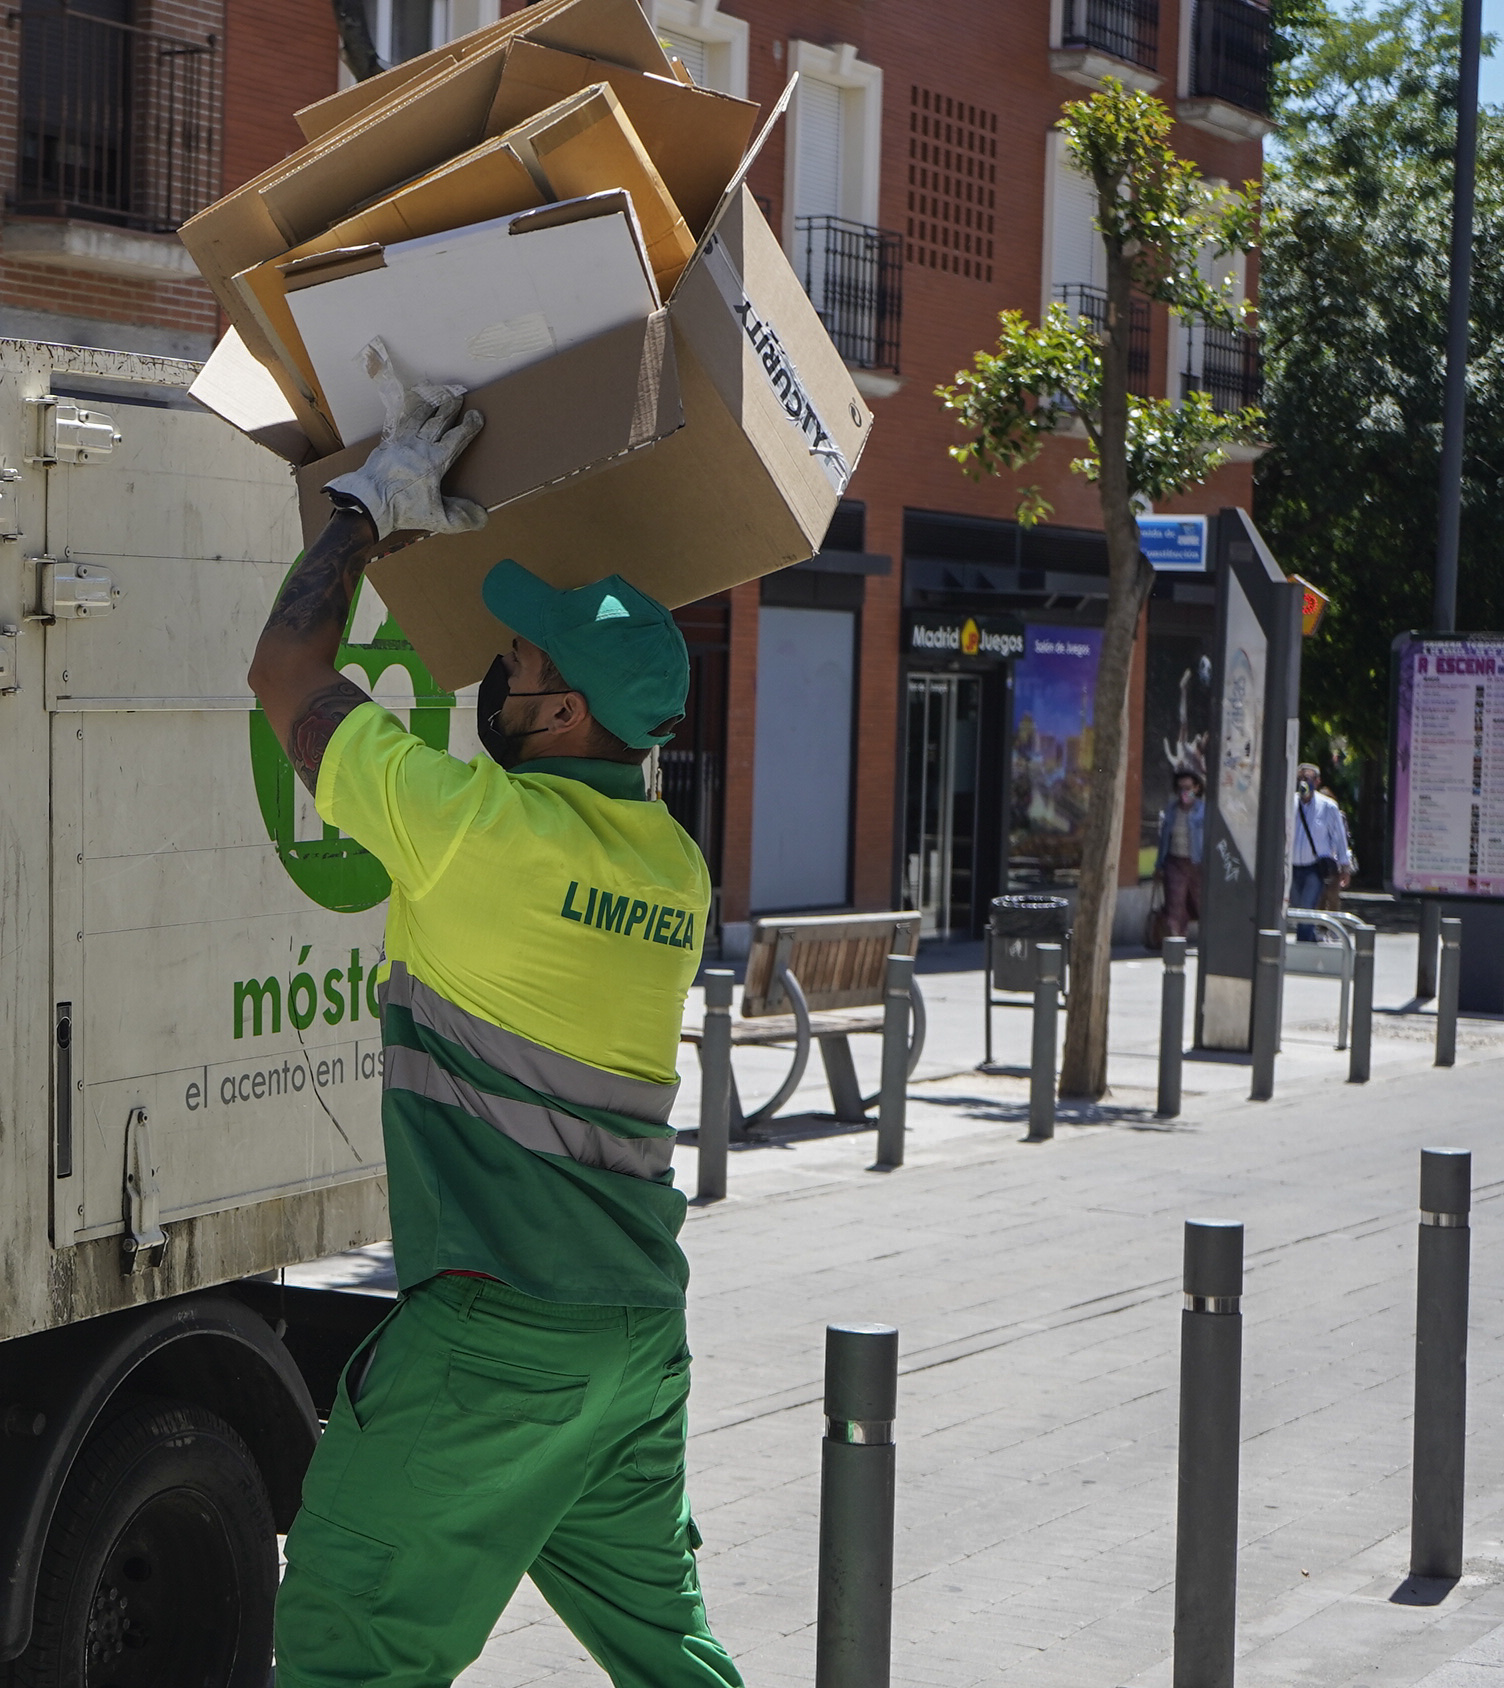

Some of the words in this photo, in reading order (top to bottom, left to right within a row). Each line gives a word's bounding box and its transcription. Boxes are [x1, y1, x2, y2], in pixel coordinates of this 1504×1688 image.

[1141, 547, 1200, 560] onstitución
[912, 625, 960, 649] Madrid
[979, 630, 1024, 657] Juegos
[1436, 658, 1495, 675] ESCENA
[561, 880, 695, 951] LIMPIEZA
[185, 1065, 208, 1112] el
[220, 1059, 306, 1106] acento
[316, 1056, 344, 1088] en
